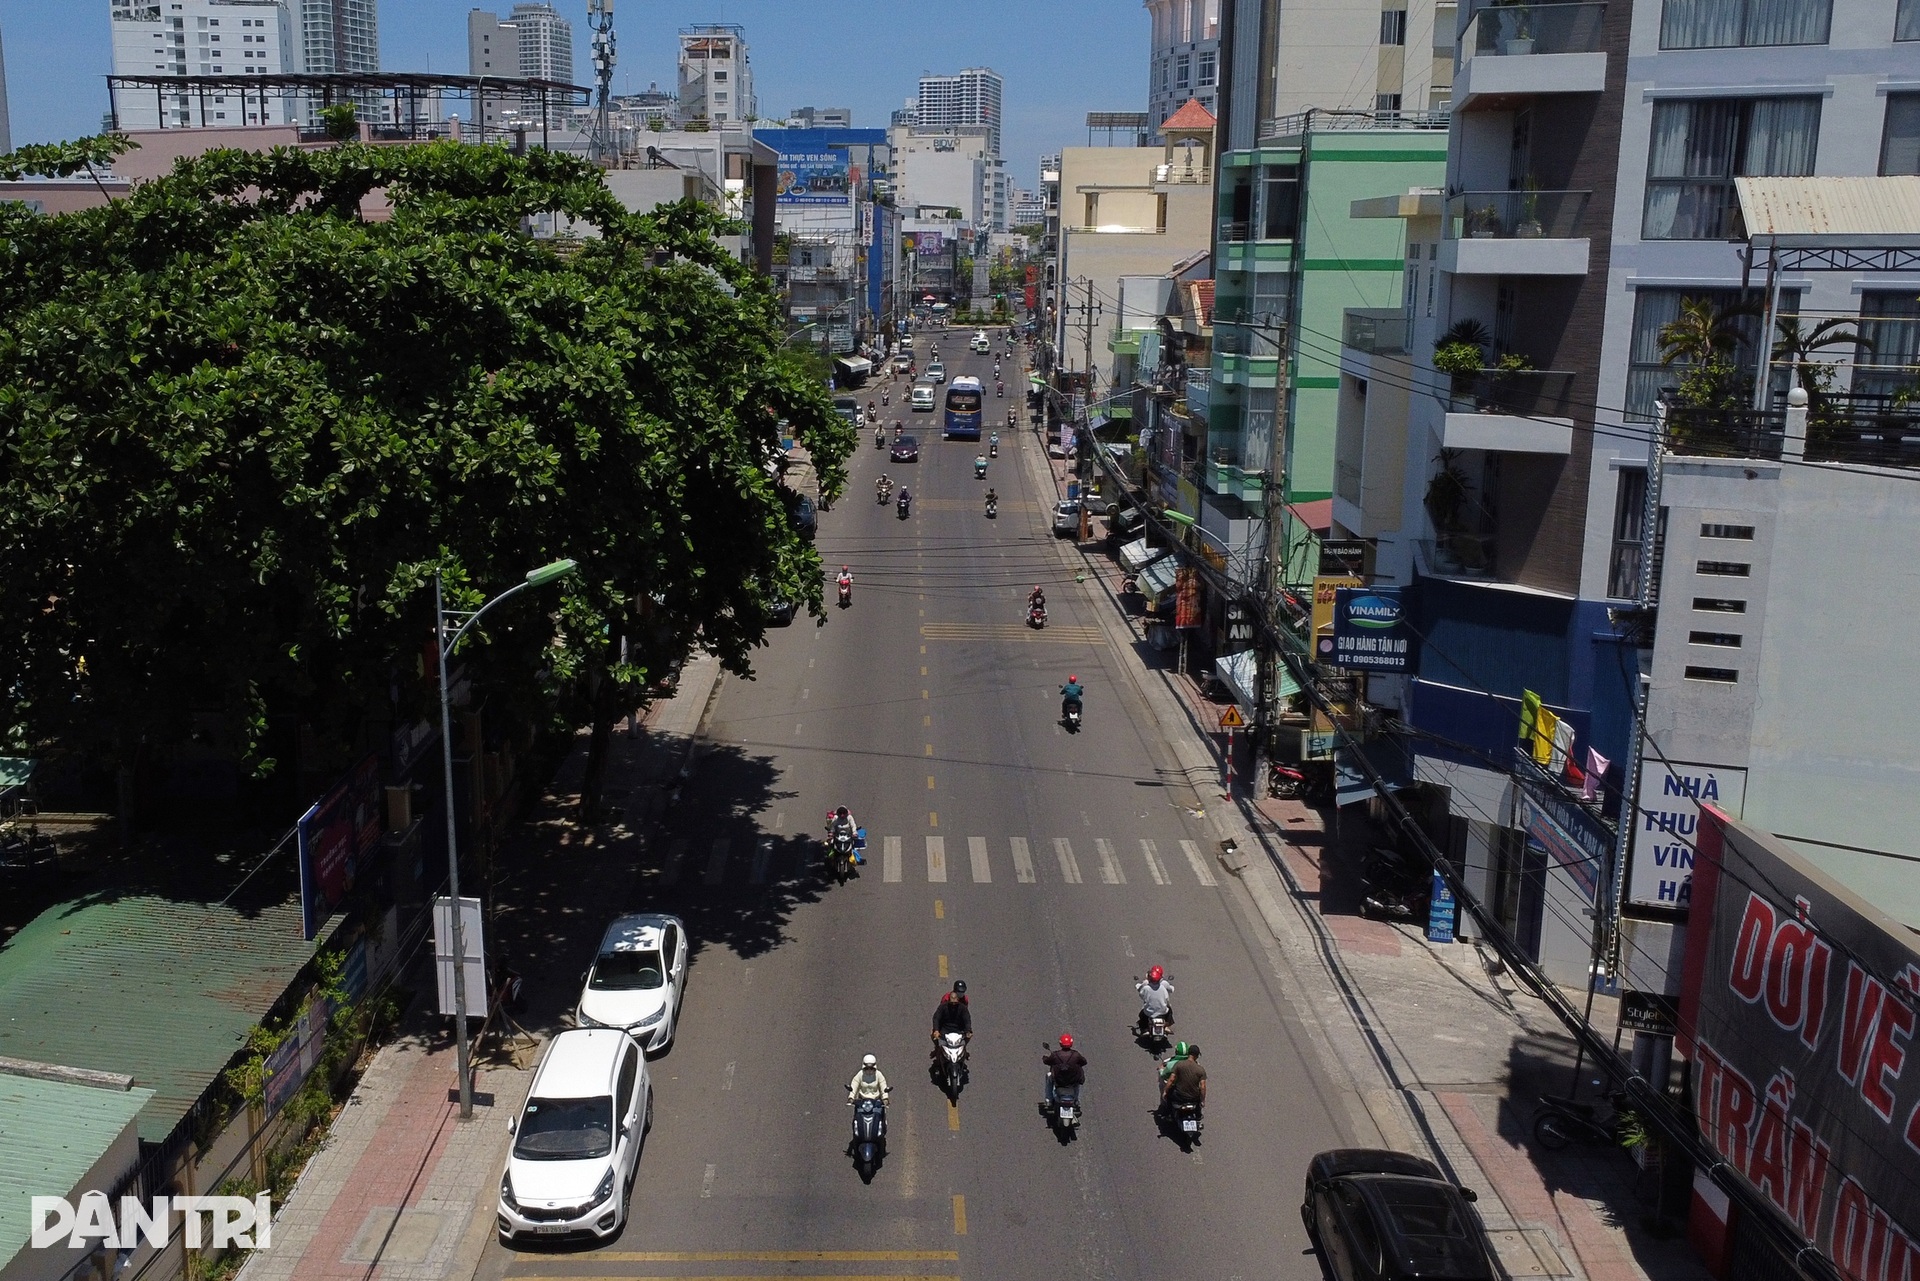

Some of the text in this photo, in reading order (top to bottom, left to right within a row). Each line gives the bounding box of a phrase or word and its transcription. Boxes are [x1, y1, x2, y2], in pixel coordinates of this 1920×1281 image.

[933, 139, 954, 147] BIDV
[1338, 635, 1408, 655] GIAO HÀNG TẬN NƠI
[1664, 773, 1719, 800] NHÀ
[1645, 810, 1697, 835] THU
[1653, 842, 1695, 870] VĨN
[1696, 1035, 1830, 1242] TRẦN
